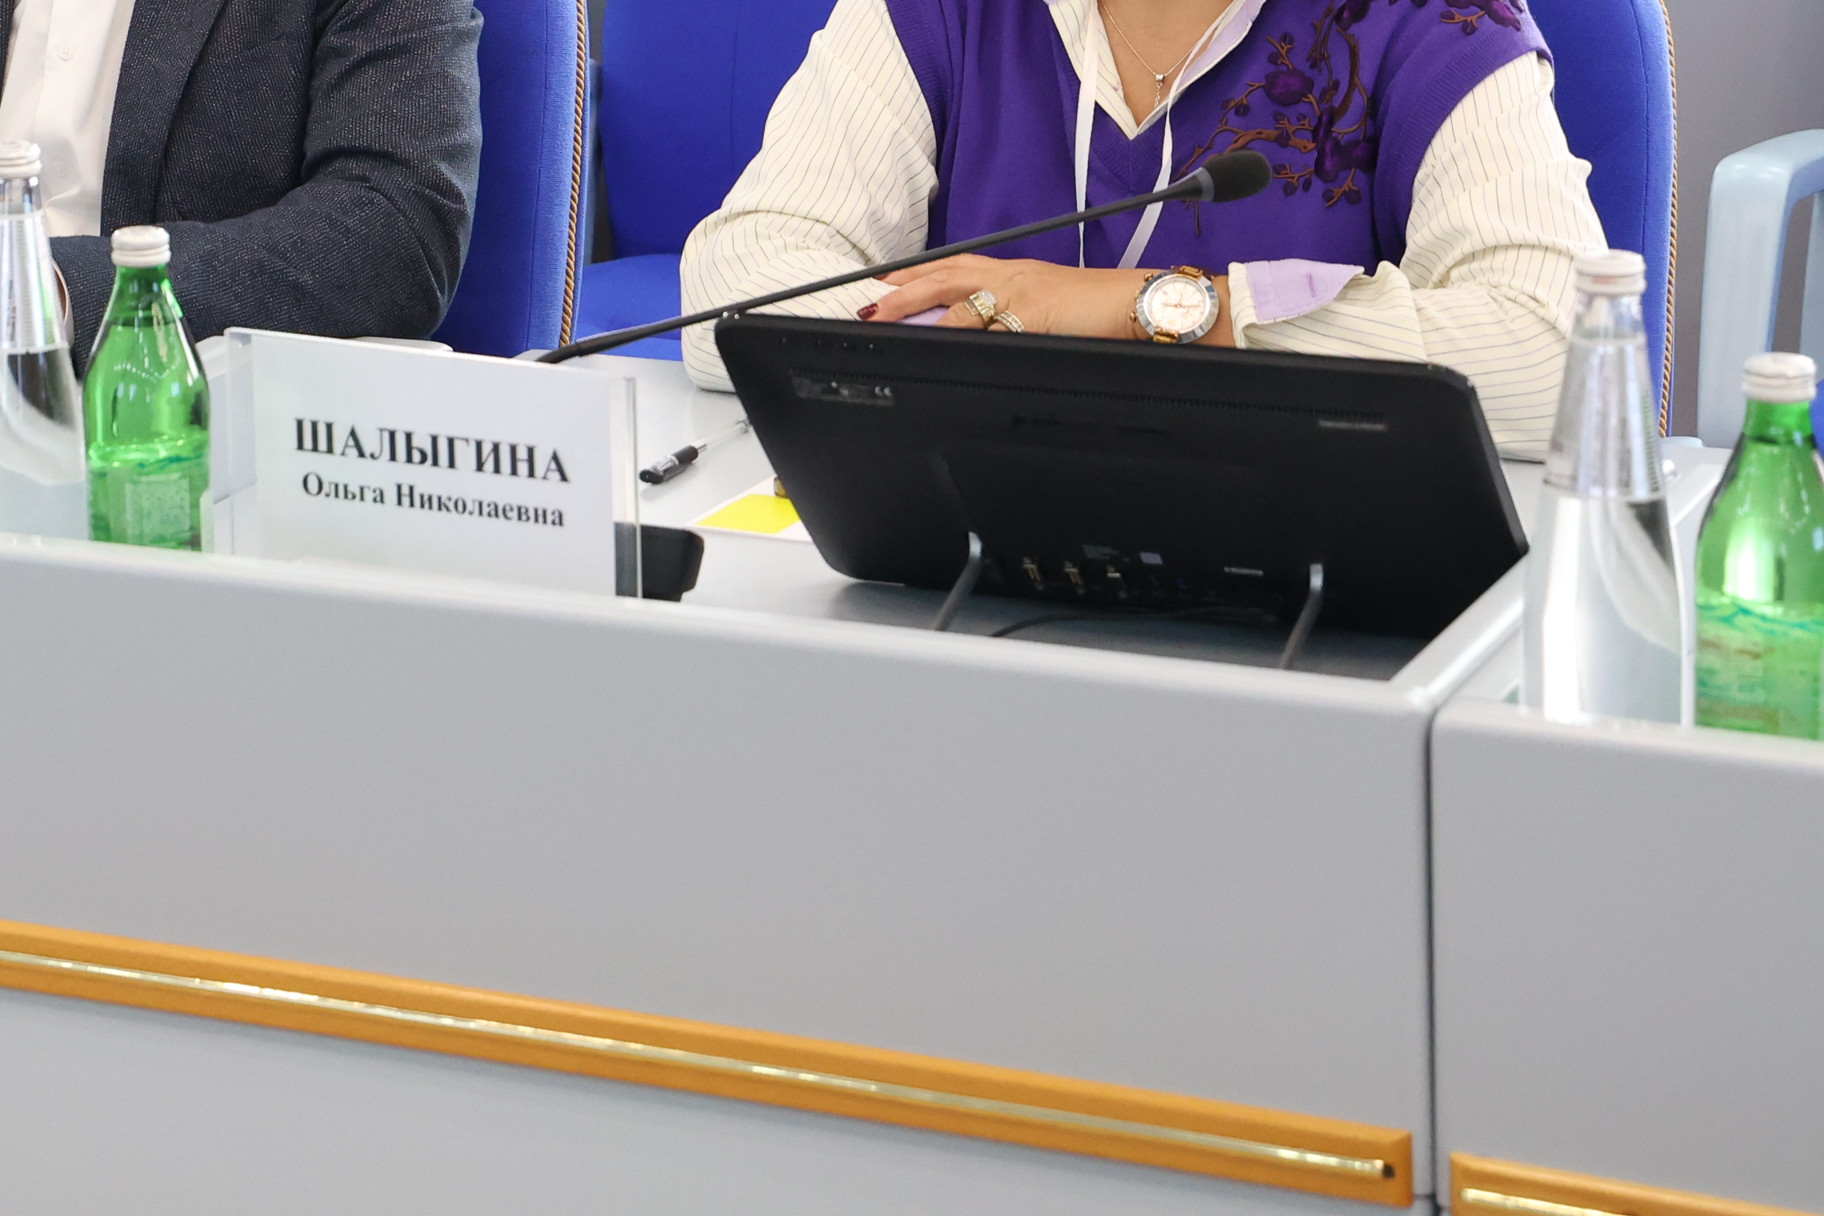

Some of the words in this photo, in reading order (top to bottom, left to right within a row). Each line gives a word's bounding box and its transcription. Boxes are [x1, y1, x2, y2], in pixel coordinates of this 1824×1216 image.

[294, 417, 570, 483] ШАЛЫГИНА
[302, 471, 386, 505] Ольга
[394, 482, 565, 528] Николаевна
